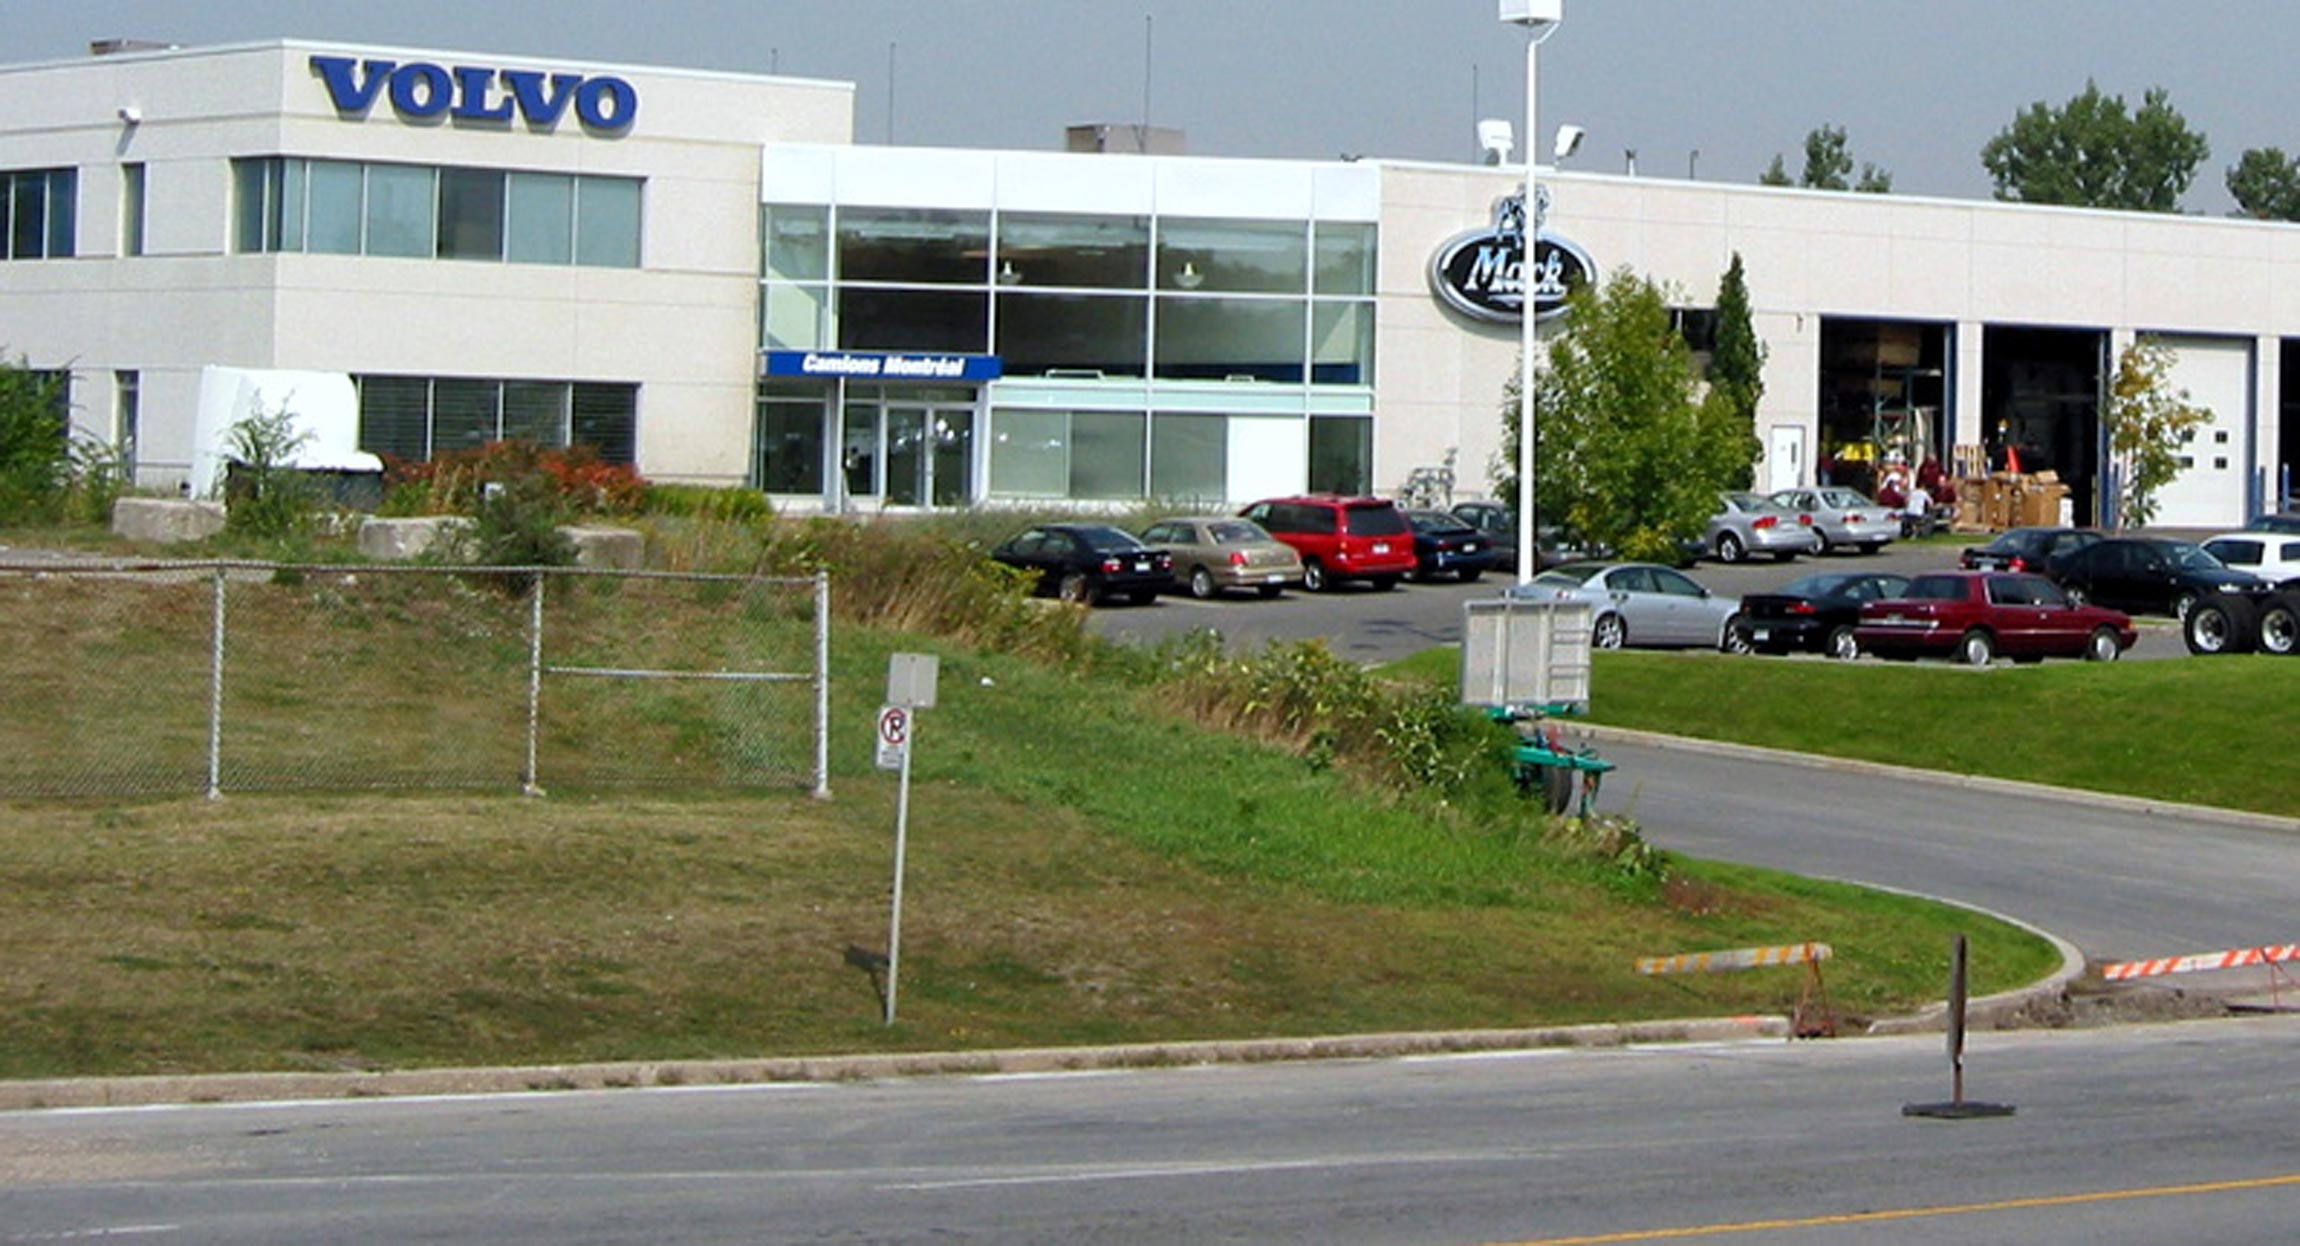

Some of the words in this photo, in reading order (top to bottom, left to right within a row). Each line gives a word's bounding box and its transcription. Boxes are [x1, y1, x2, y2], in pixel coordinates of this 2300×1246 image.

[309, 56, 637, 132] VOLVO
[802, 354, 880, 374] Camions
[883, 356, 966, 376] Montréal
